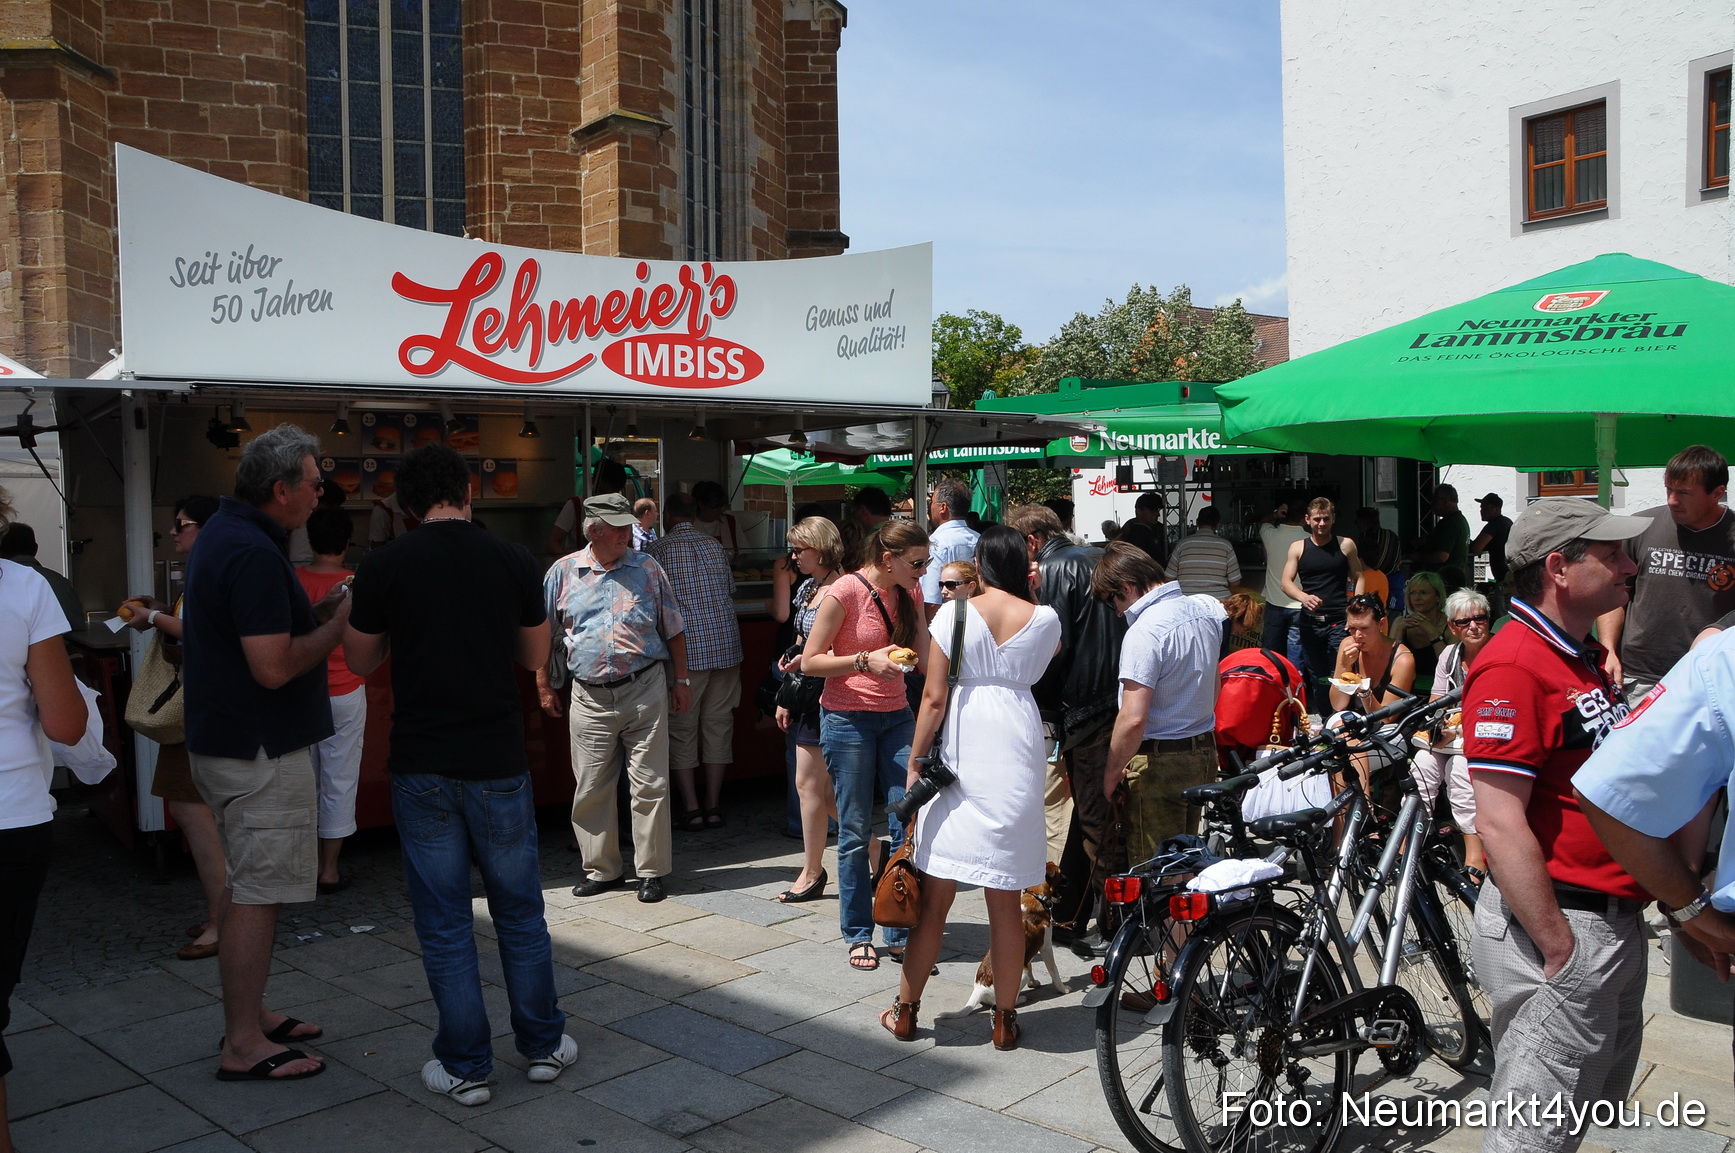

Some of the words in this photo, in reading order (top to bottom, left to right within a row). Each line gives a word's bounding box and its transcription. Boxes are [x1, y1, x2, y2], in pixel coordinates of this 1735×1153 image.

[169, 251, 223, 288] Seit
[227, 243, 283, 284] über
[210, 294, 243, 325] 50
[250, 279, 334, 323] Jahren
[391, 251, 737, 385] Lehmeier's
[805, 304, 860, 332] Genuss
[864, 288, 895, 323] und
[1408, 322, 1690, 350] Lammsbräu
[1457, 311, 1658, 331] Neumarkter
[836, 325, 906, 361] Qualität!
[1396, 355, 1432, 363] DAS
[1436, 353, 1483, 361] FEINE
[1488, 346, 1627, 359] ÖKOLOGISCHE
[1634, 344, 1678, 353] BIER
[624, 341, 746, 381] IMBISS
[1099, 428, 1227, 451] Neumarkte
[1650, 551, 1725, 574] SPECIA
[1575, 687, 1611, 719] 63
